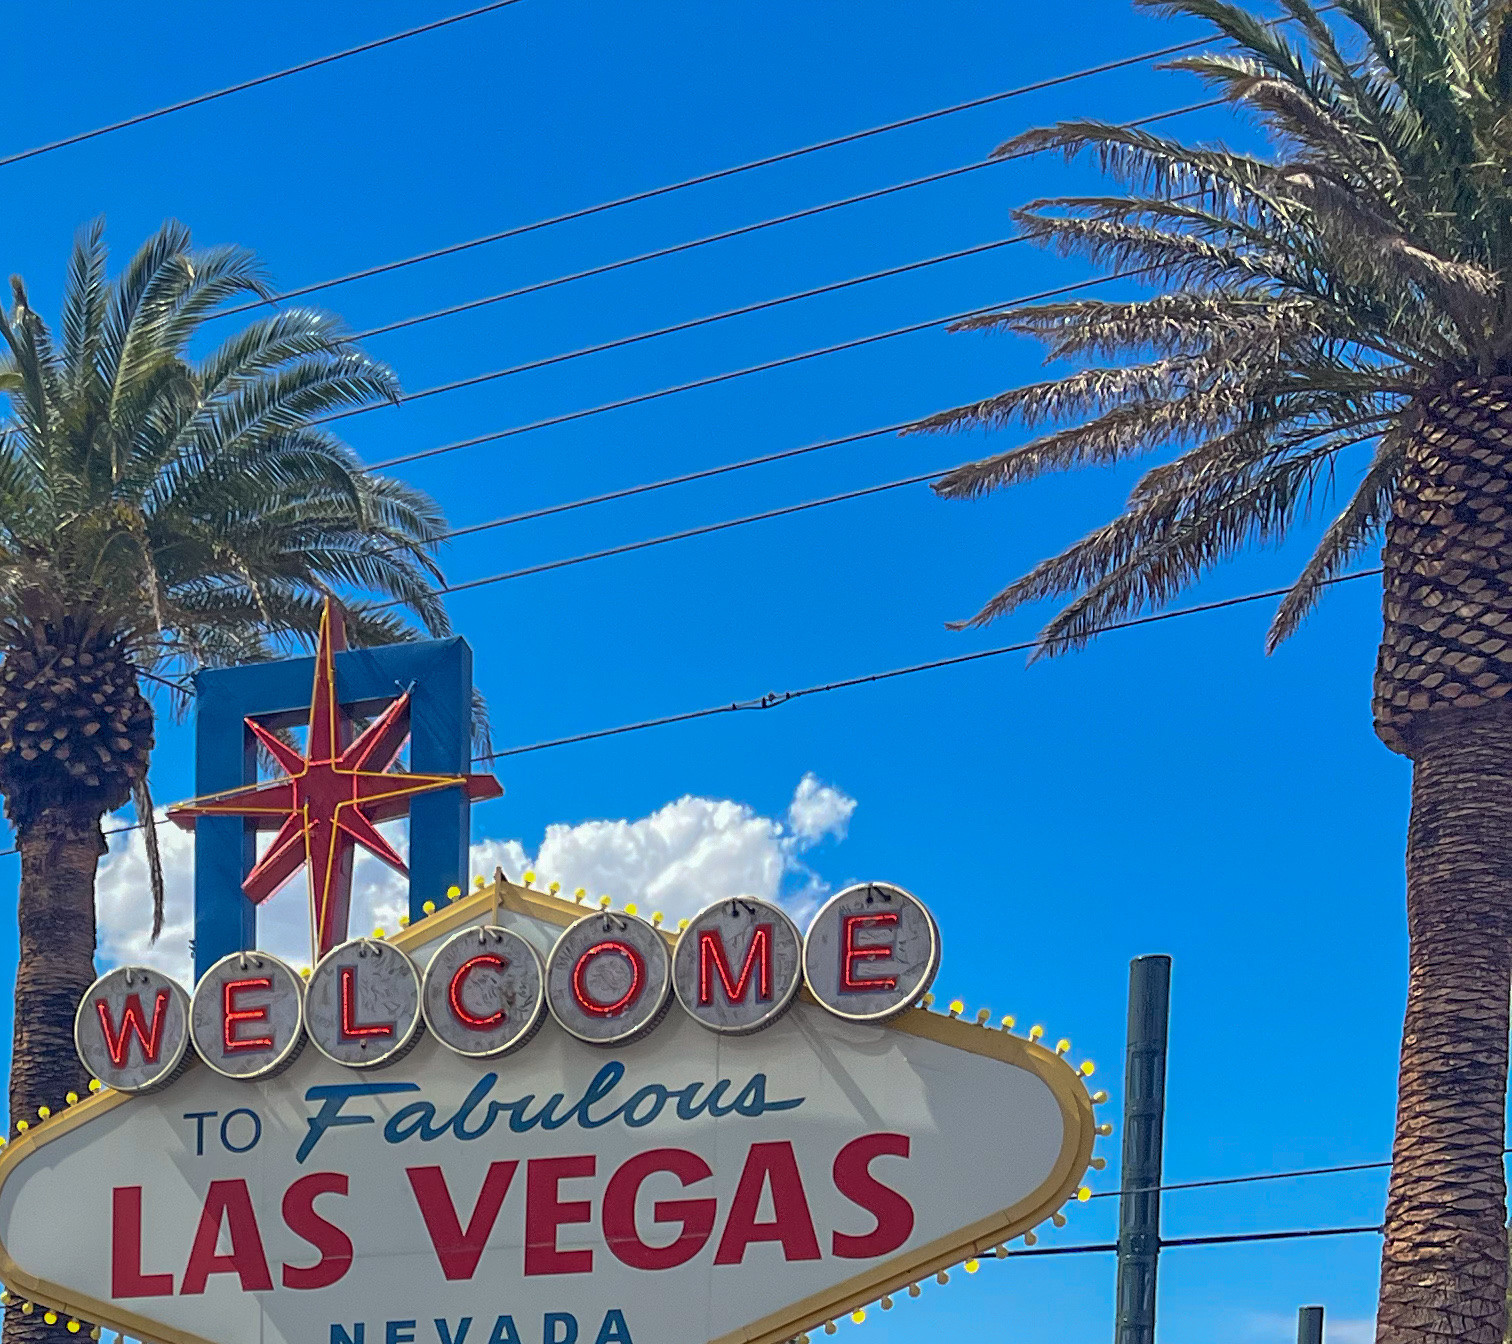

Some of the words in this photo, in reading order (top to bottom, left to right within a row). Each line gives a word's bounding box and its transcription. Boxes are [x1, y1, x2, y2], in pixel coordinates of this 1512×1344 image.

[95, 909, 904, 1071] WELCOME
[182, 1107, 263, 1157] TO
[295, 1060, 806, 1164] Fabulous
[110, 1171, 355, 1299] LAS
[405, 1132, 916, 1282] VEGAS
